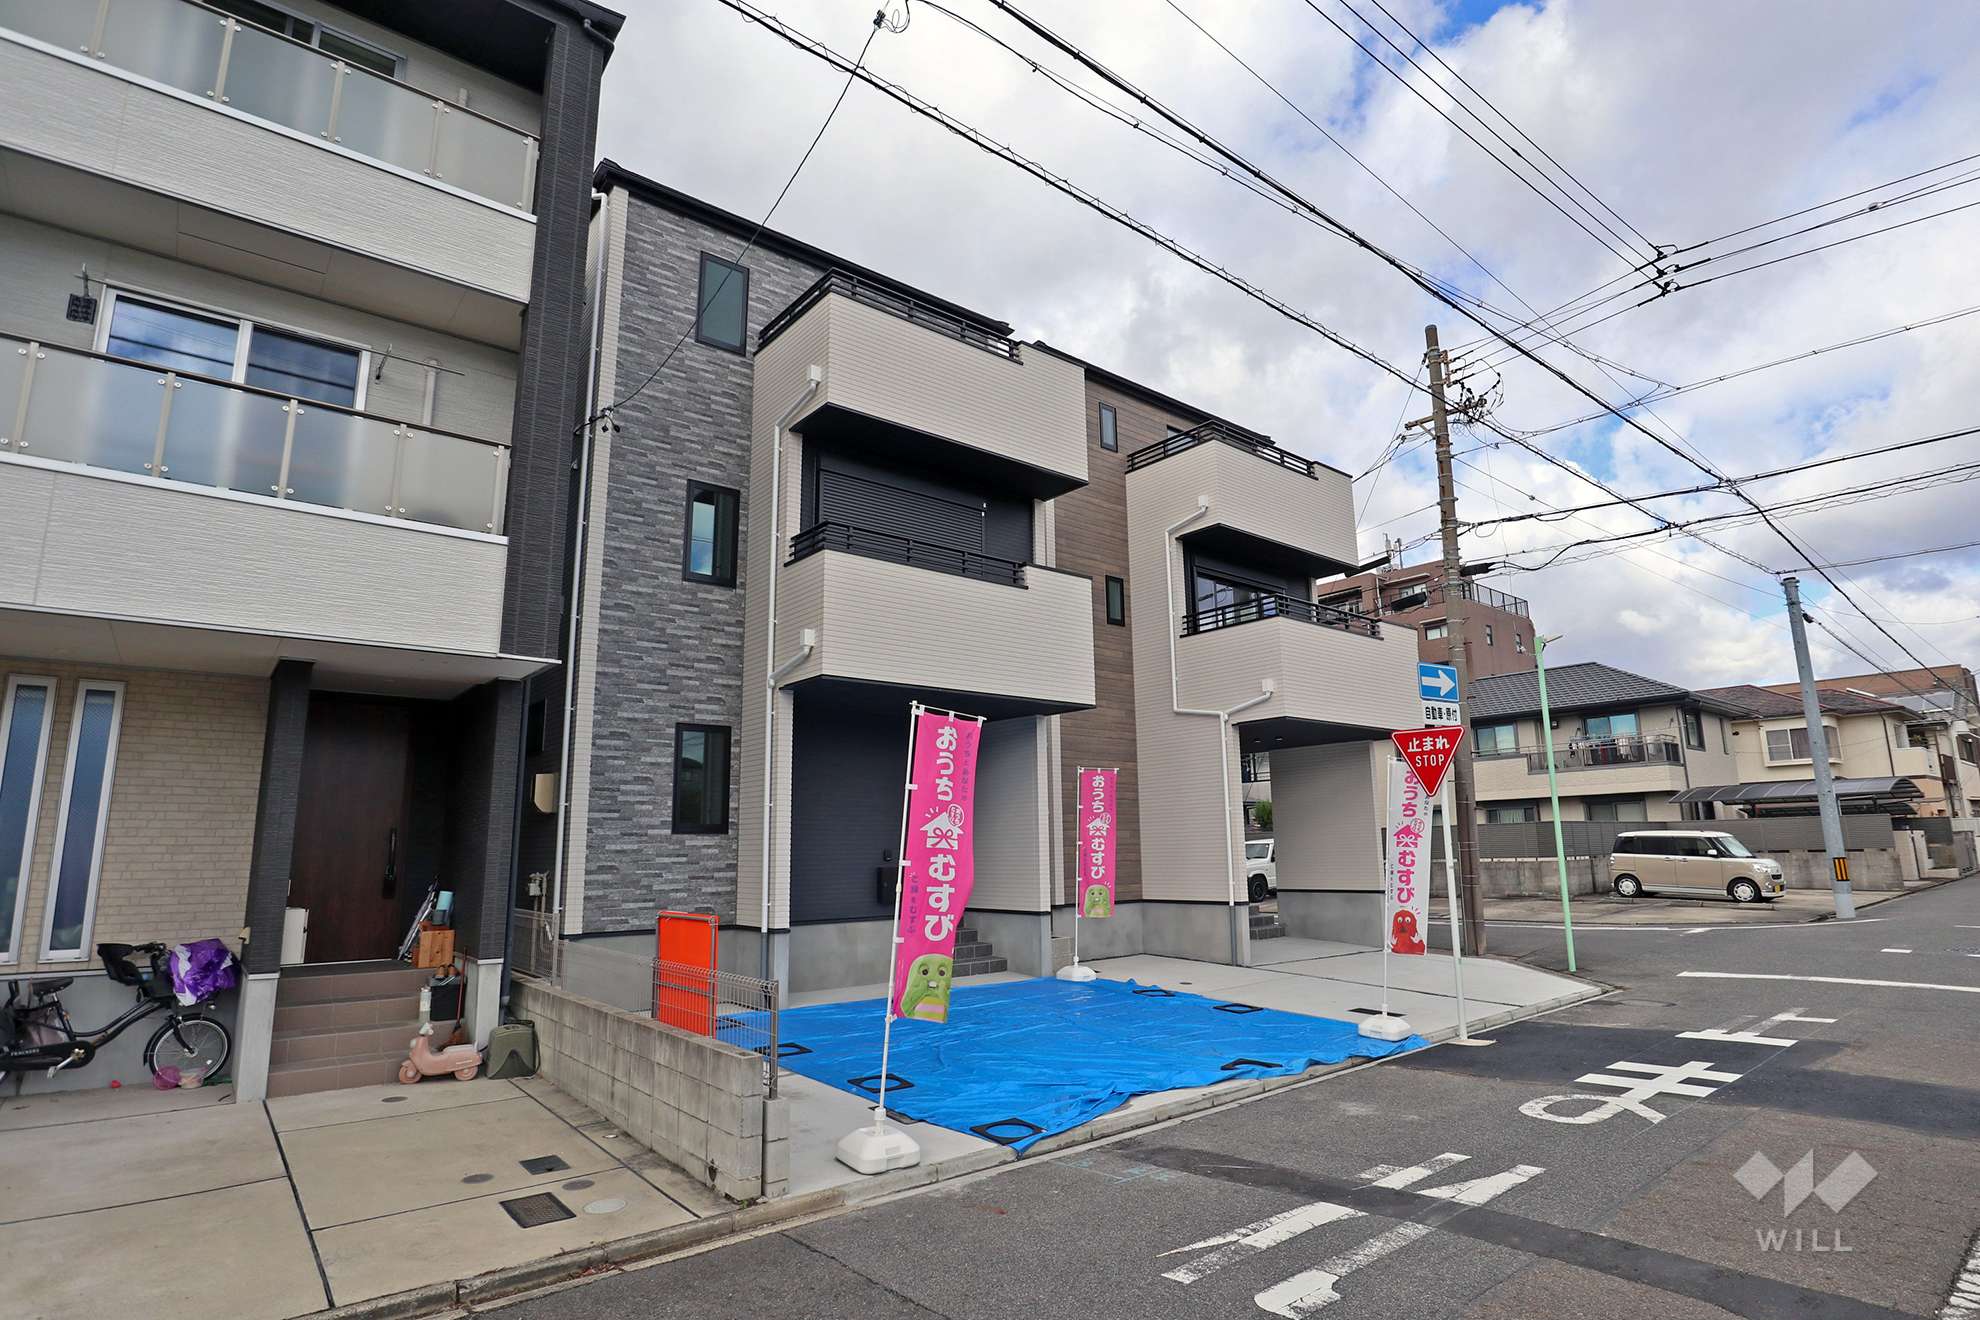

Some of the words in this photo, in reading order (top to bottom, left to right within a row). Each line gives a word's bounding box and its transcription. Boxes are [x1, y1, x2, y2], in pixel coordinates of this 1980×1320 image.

[935, 725, 959, 801] おうち
[1407, 735, 1450, 752] 止まれ
[1415, 754, 1445, 768] STOP
[1091, 775, 1105, 813] おうち
[1091, 837, 1106, 880] むすび
[1396, 849, 1416, 904] むすび
[924, 853, 956, 942] むすび
